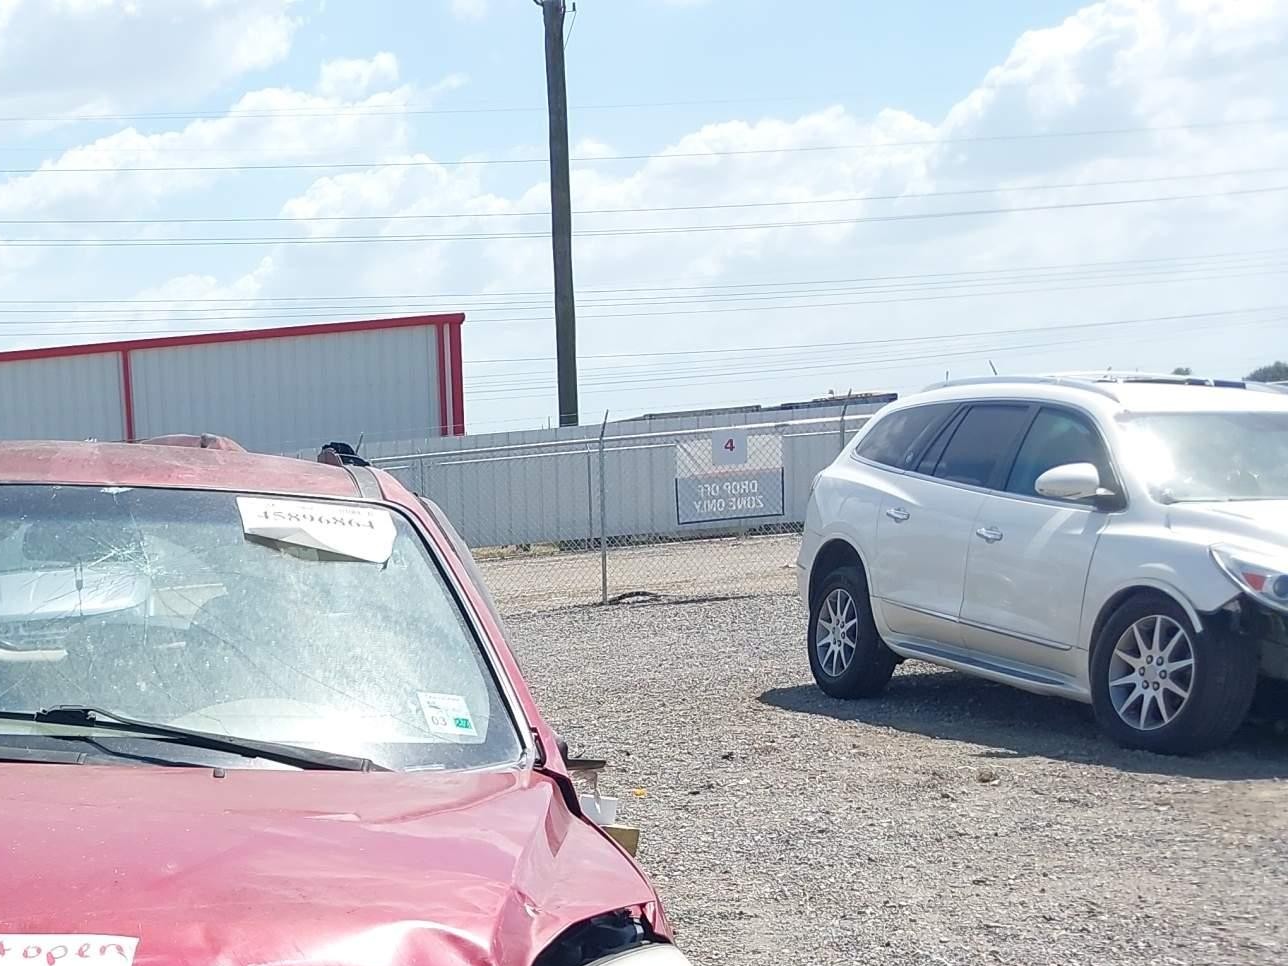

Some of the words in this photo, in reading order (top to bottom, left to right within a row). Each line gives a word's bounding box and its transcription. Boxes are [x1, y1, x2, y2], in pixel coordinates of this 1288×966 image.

[724, 438, 735, 451] 4
[257, 510, 375, 530] 45896864
[22, 942, 129, 966] open
